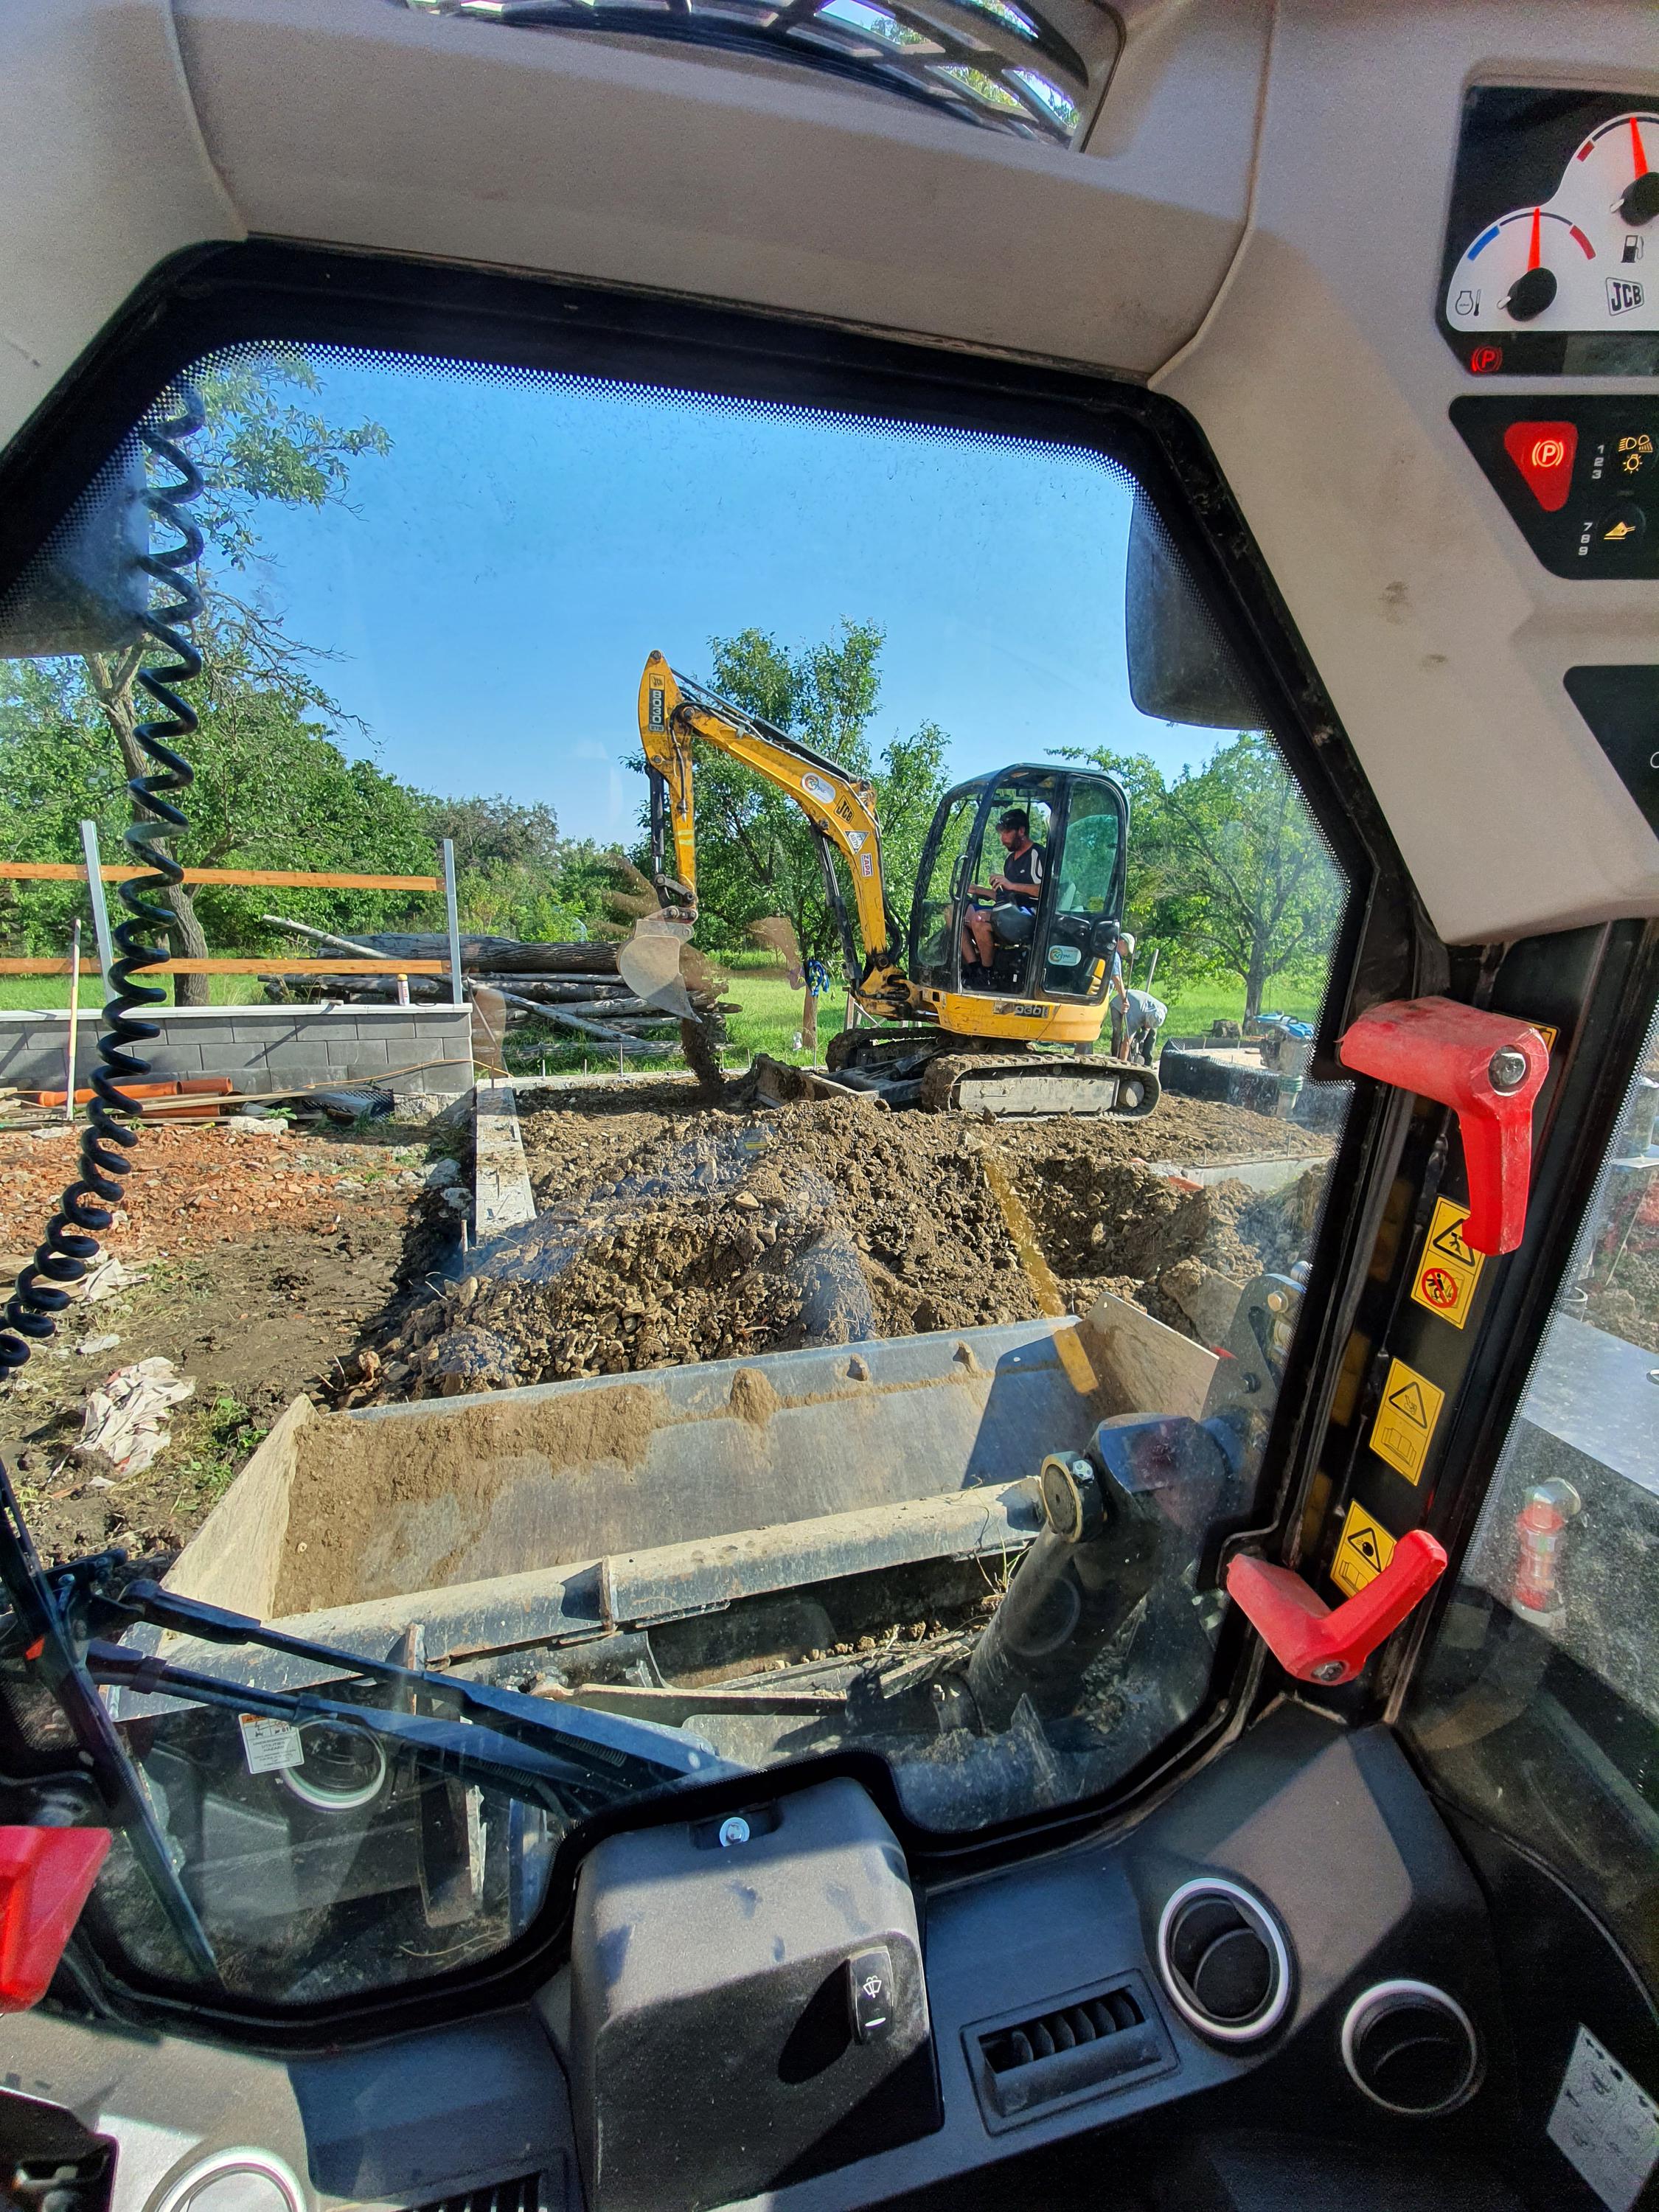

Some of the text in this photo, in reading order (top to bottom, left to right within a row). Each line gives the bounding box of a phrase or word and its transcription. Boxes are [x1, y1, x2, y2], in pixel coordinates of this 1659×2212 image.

[1611, 282, 1642, 311] JCB
[1543, 445, 1556, 462] P
[1598, 445, 1604, 453] 1
[1594, 457, 1604, 466] 2
[1592, 470, 1601, 479] 3
[1584, 522, 1593, 532] 7
[1581, 535, 1590, 543] 8
[1579, 546, 1588, 555] 9
[652, 689, 662, 724] 8030
[836, 800, 853, 822] JCB
